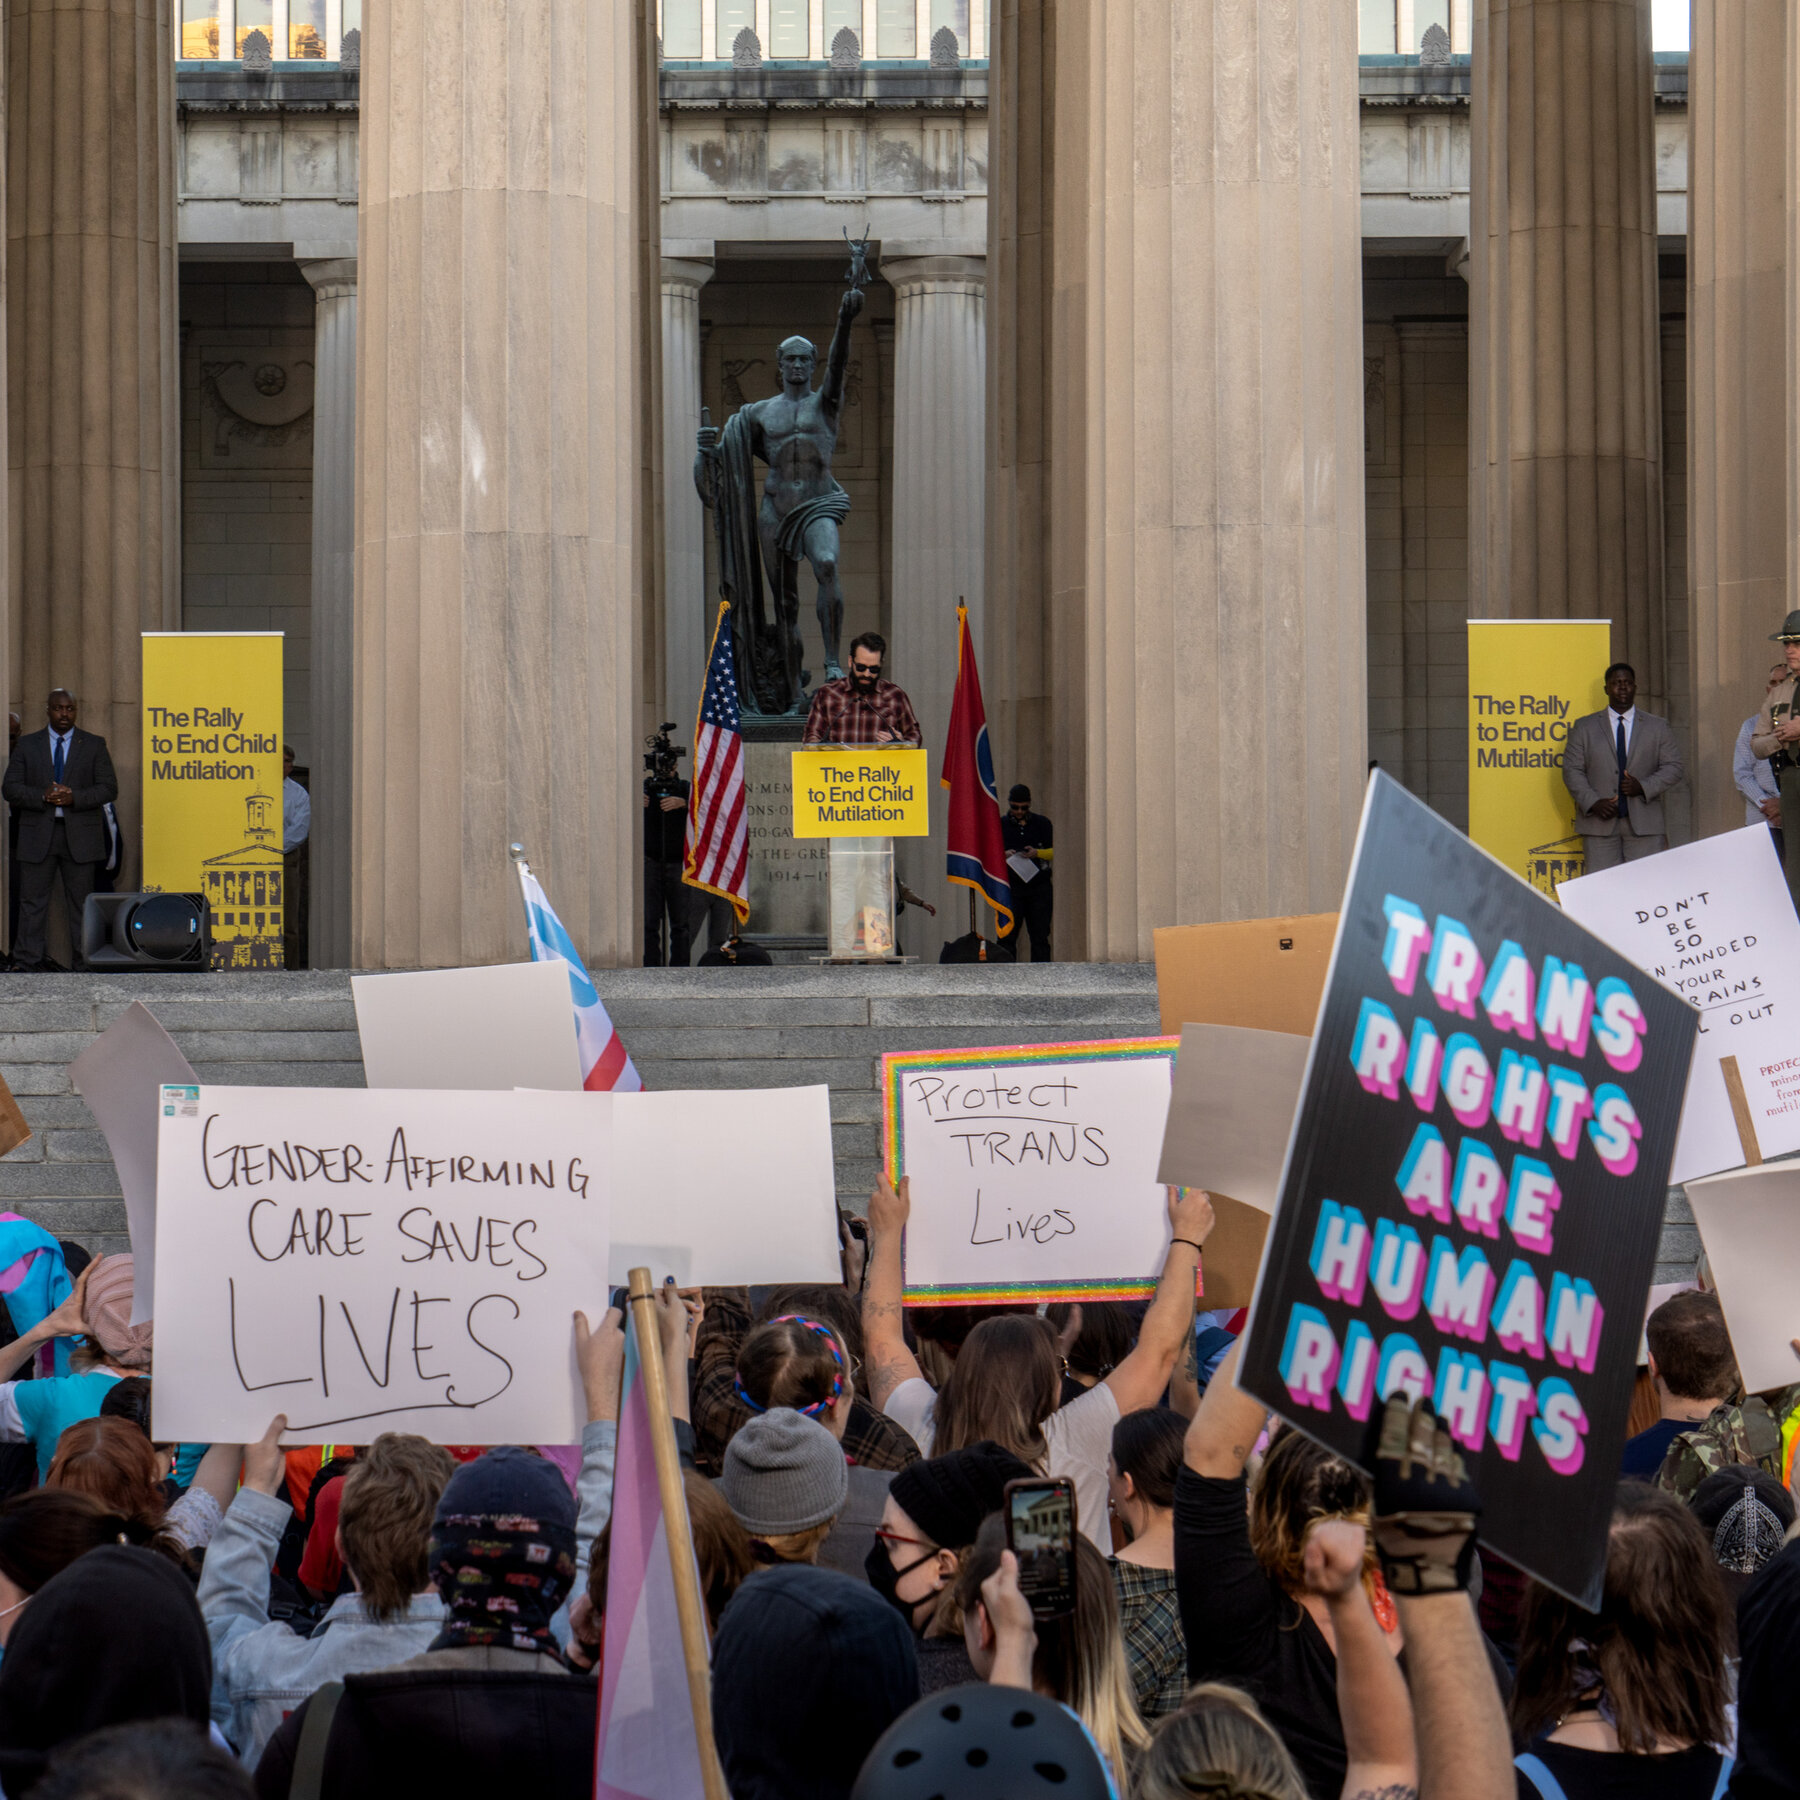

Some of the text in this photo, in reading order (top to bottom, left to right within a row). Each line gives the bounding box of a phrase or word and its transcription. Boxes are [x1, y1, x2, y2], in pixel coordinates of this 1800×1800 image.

[147, 707, 244, 731] The Rally
[1473, 695, 1570, 719] The Rally
[151, 733, 277, 753] to End Child
[1477, 722, 1499, 741] to
[1503, 721, 1545, 741] End
[152, 760, 254, 780] Mutilation
[1477, 748, 1564, 768] Mutilatio
[820, 766, 900, 785] The Rally
[760, 783, 792, 793] MEM
[808, 785, 913, 803] to End Child
[747, 805, 774, 816] ONS
[818, 805, 904, 821] Mutilation
[748, 827, 767, 838] HO
[763, 848, 790, 860] THE
[798, 848, 826, 860] GRE
[1635, 891, 1710, 924] DON'T
[1666, 917, 1696, 935] BE
[1674, 934, 1702, 952] SO
[1648, 935, 1758, 978] N-MINDED
[1382, 893, 1647, 1073] TRANS
[1675, 968, 1726, 992] YOUR
[1689, 976, 1762, 1007] RAINS
[1730, 1003, 1774, 1025] OUT
[909, 1073, 1078, 1116] Protect
[1349, 996, 1642, 1177] RIGHTS
[1766, 1099, 1799, 1117] mutil
[950, 1127, 1109, 1167] TRANS
[1395, 1121, 1562, 1255] ARE
[971, 1188, 1075, 1244] Lives
[249, 1199, 547, 1281] CARE SAVES
[1308, 1198, 1604, 1374] HUMAN
[229, 1277, 519, 1408] LIVES
[1278, 1301, 1589, 1475] RIGHTS
